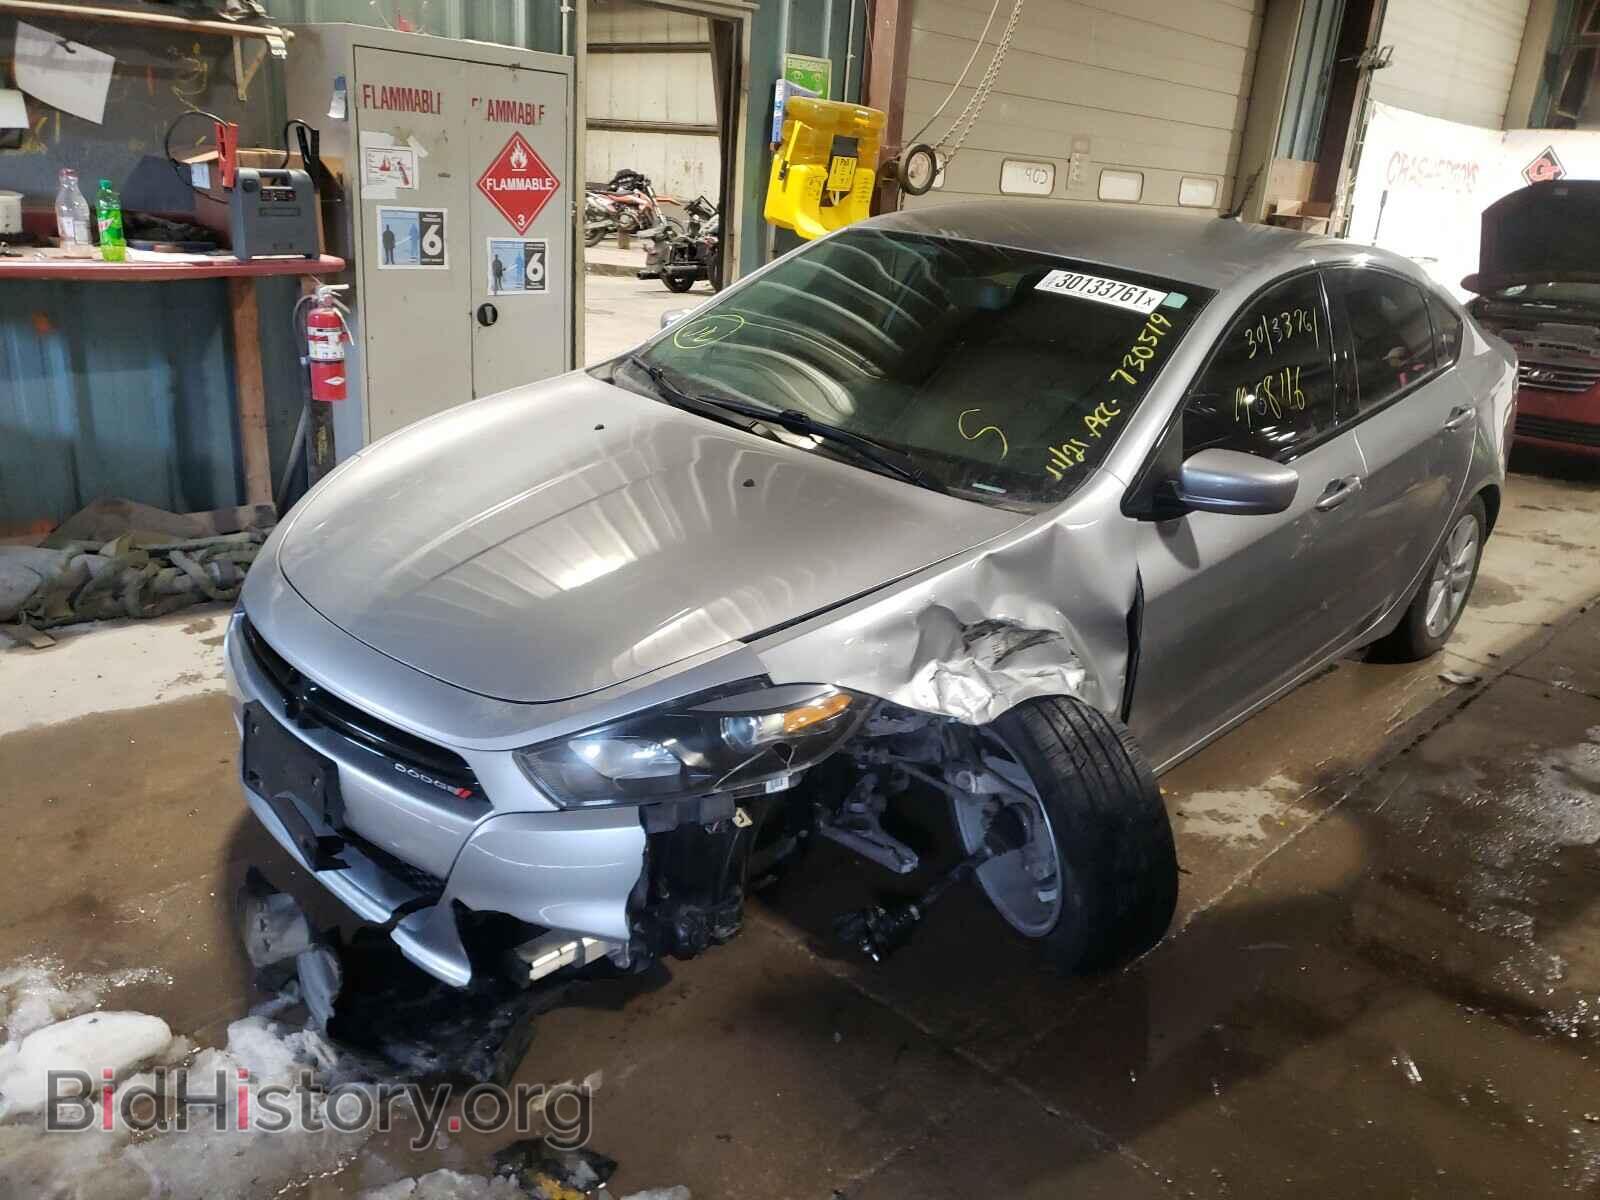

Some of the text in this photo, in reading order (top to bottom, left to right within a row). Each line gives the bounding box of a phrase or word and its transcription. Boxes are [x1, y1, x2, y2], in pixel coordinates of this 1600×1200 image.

[486, 177, 553, 191] FLAMMABLE
[516, 213, 526, 227] 3
[421, 223, 443, 257] 6
[525, 252, 544, 282] 6
[1109, 312, 1173, 385] 730519
[394, 762, 458, 795] DODGE
